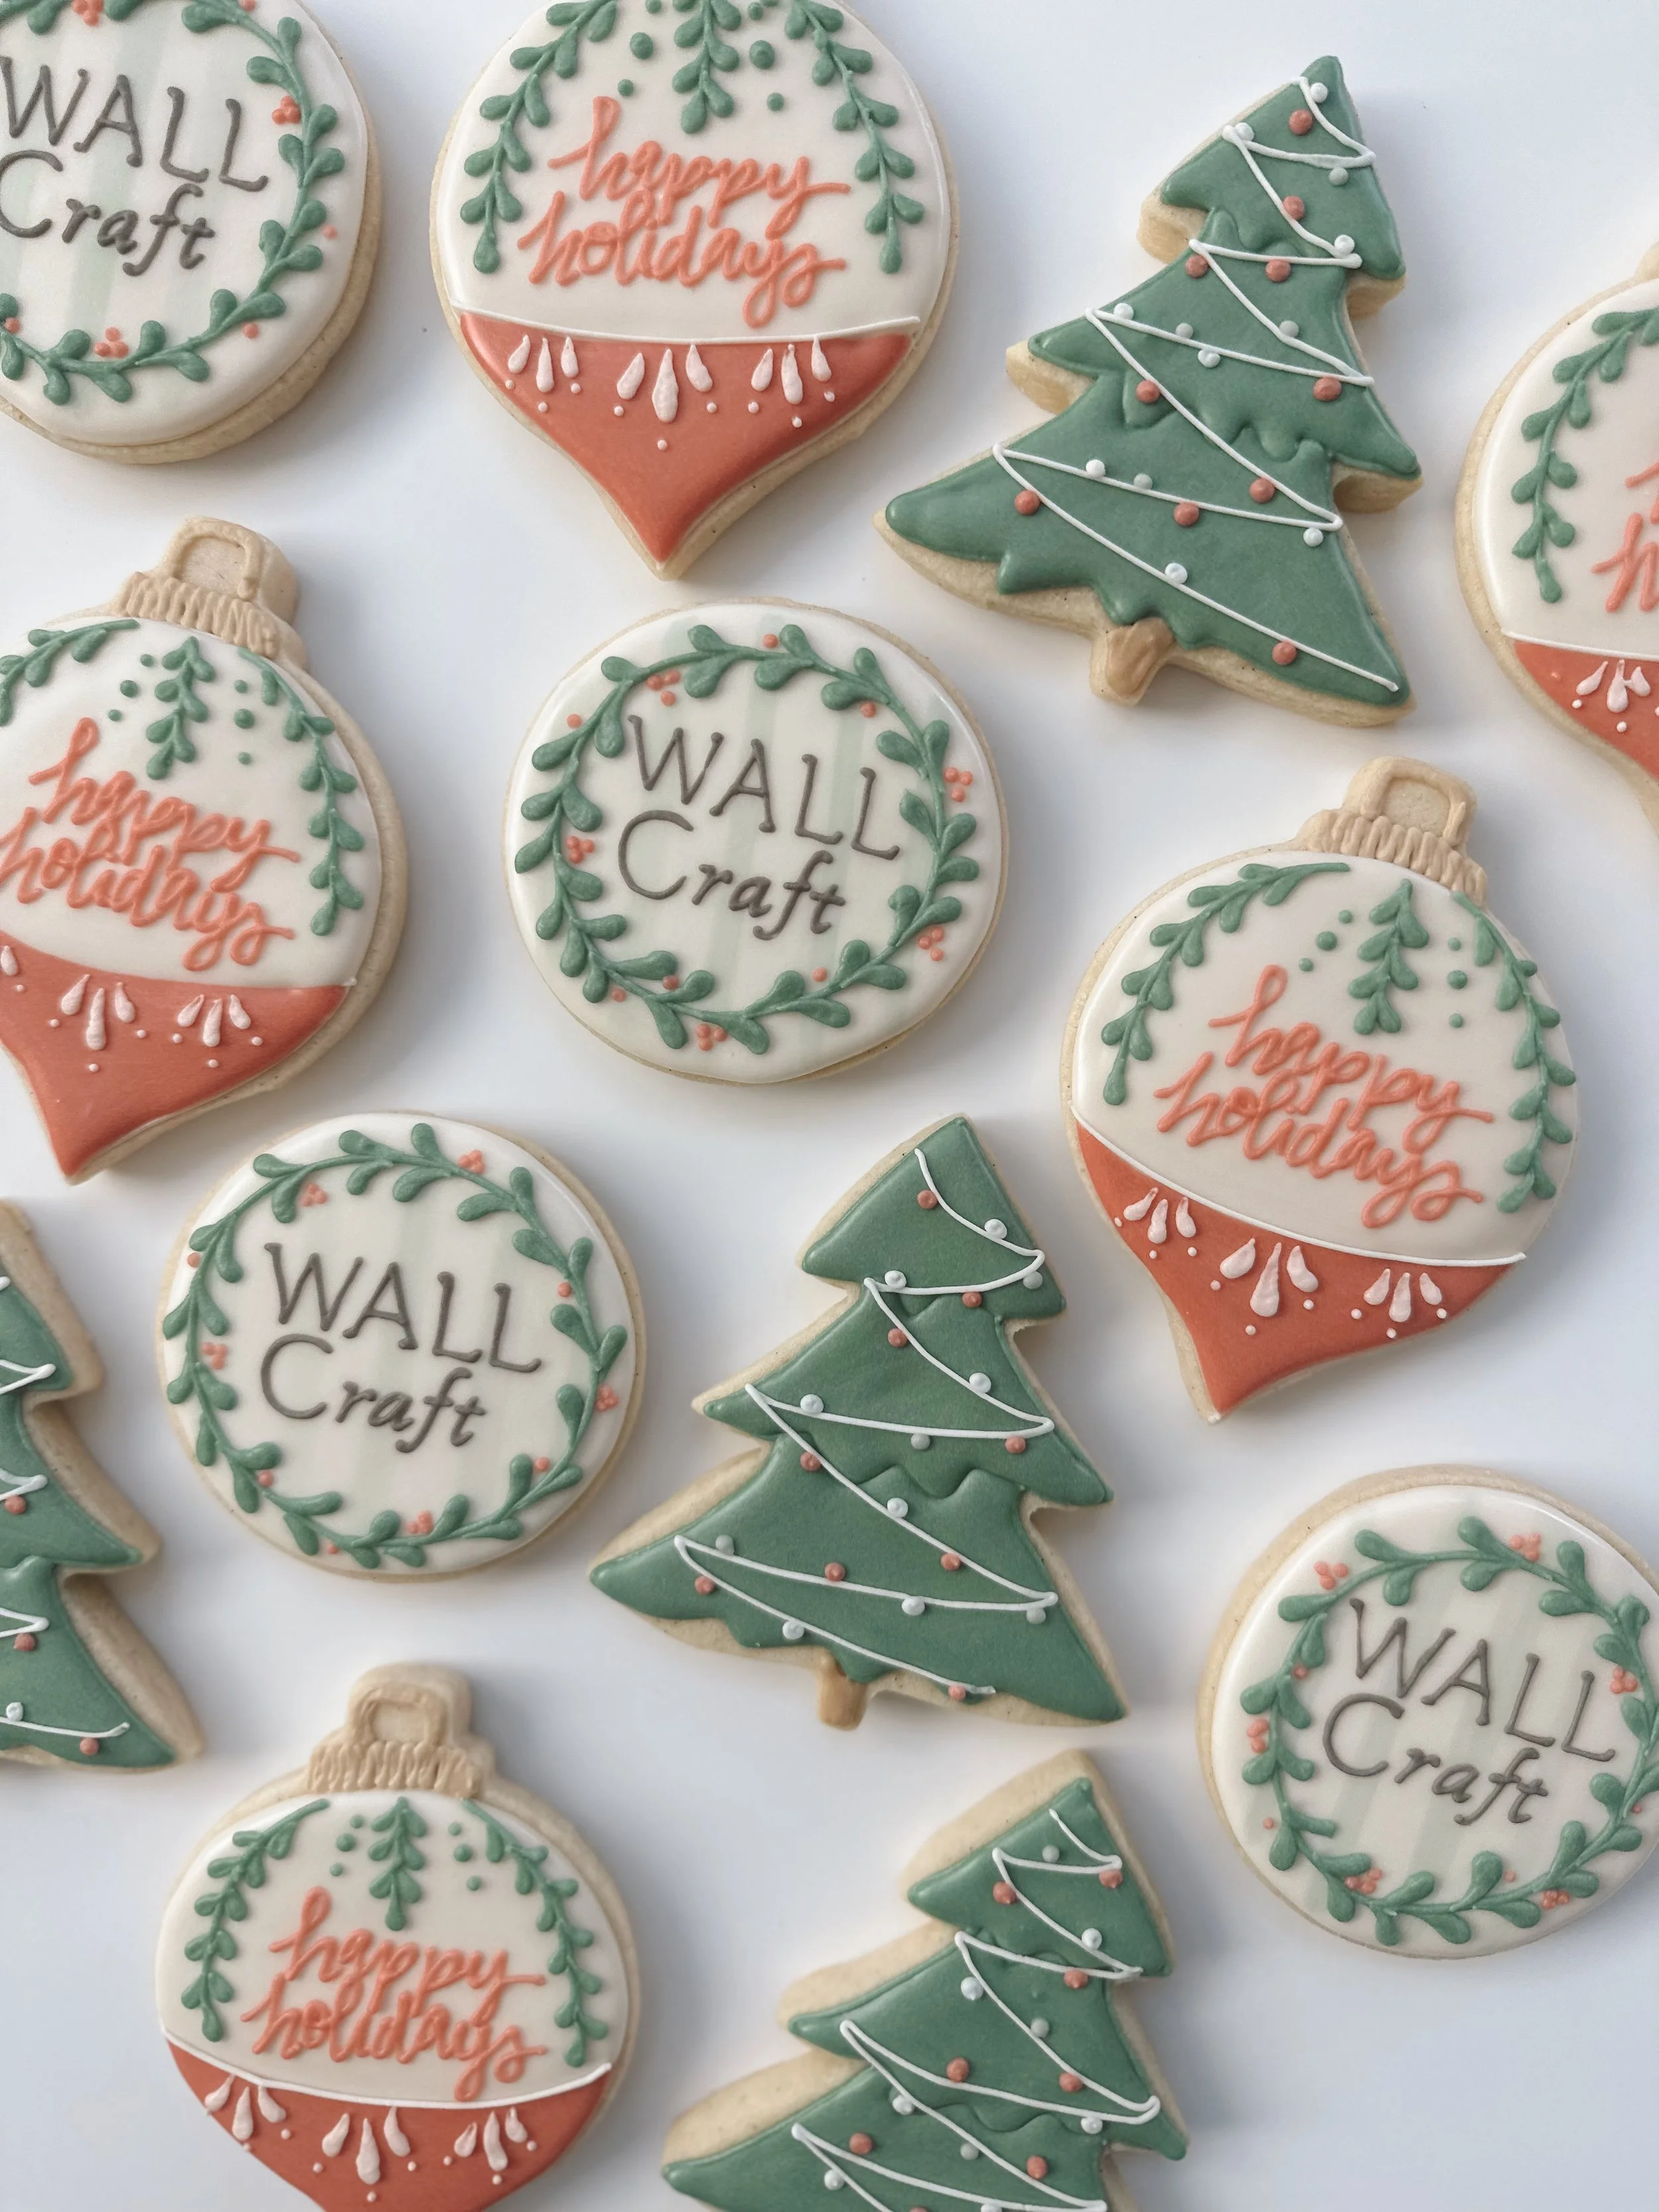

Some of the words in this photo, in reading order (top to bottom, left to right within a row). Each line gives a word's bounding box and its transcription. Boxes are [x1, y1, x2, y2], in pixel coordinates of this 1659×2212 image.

[0, 56, 269, 191] WALL
[548, 96, 851, 239] happy
[0, 150, 216, 276] Craft
[517, 190, 846, 329] holidays
[29, 717, 301, 893] happy
[628, 715, 900, 860] WALL
[618, 810, 845, 940] Craft
[1208, 964, 1493, 1154] happy
[1153, 1051, 1483, 1228] holidays
[264, 1242, 541, 1372] WALL
[261, 1333, 486, 1453] Craft
[1350, 1598, 1615, 1761] WALL
[1323, 1693, 1548, 1826] Craft
[268, 1885, 546, 2027] happy
[240, 1973, 547, 2102] holidays
